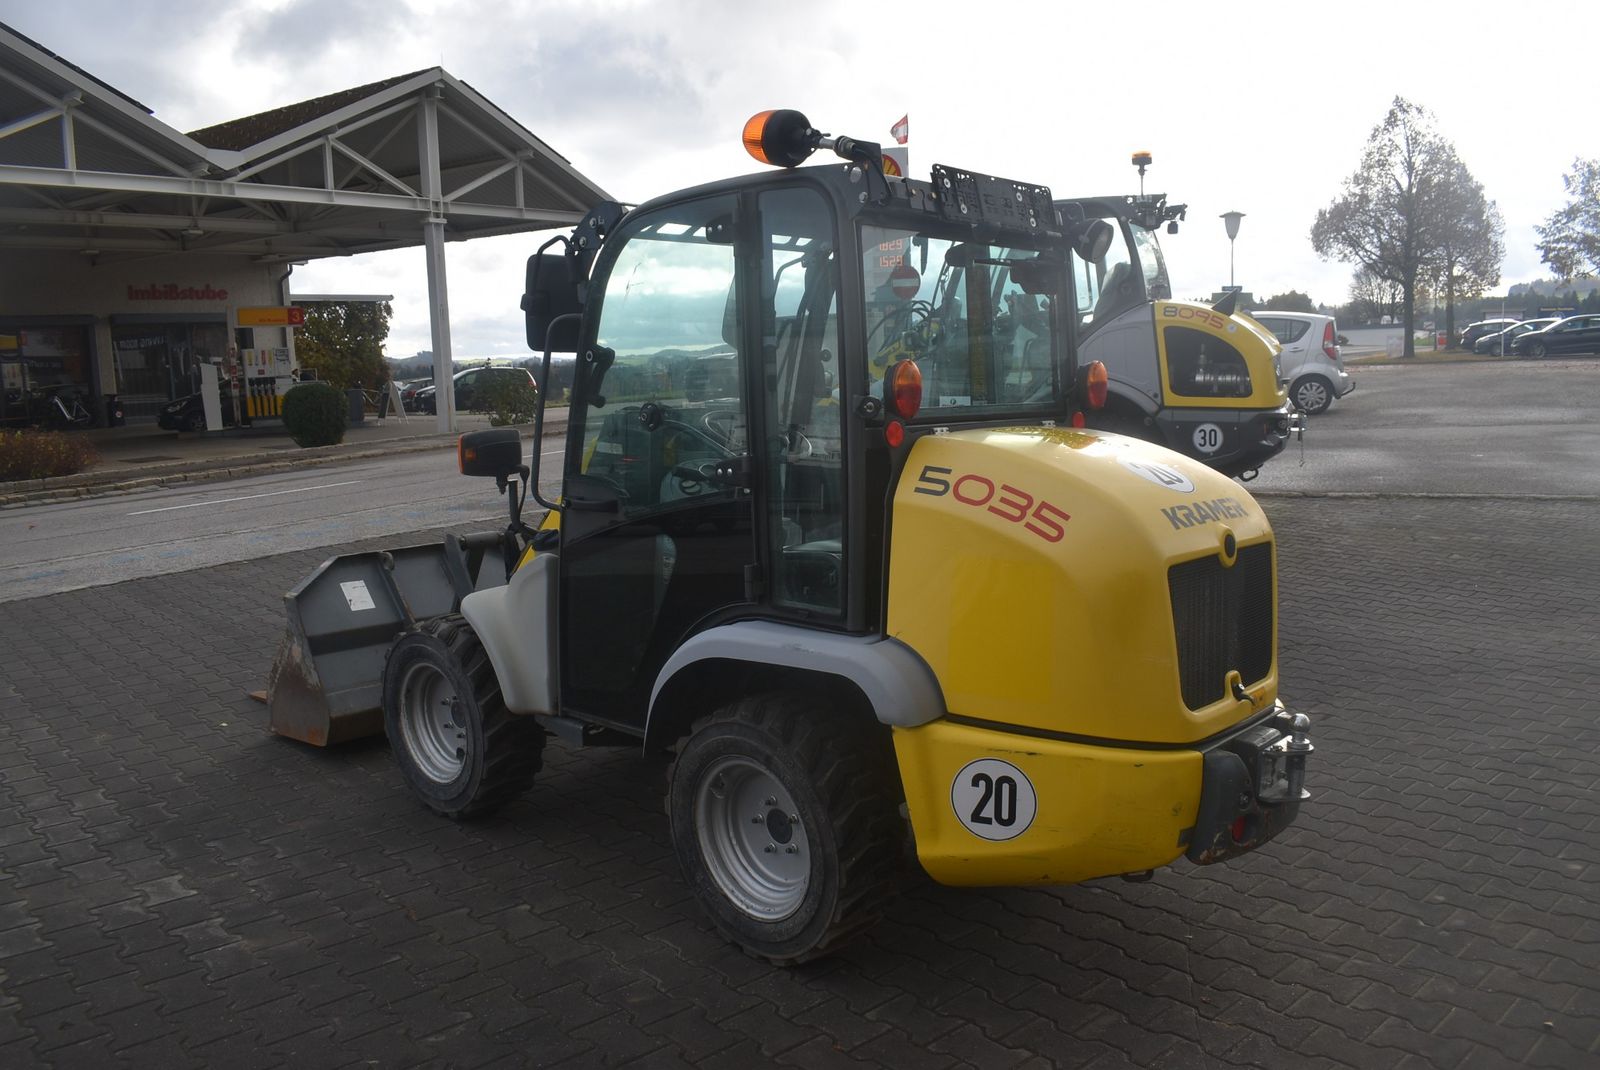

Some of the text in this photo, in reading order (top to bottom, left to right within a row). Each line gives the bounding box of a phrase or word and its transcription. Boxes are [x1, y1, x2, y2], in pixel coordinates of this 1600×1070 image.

[127, 283, 229, 301] Imbißstube
[292, 311, 300, 322] 3
[1163, 305, 1225, 329] 8095
[1198, 429, 1218, 448] 30
[913, 465, 1072, 544] 5035
[1160, 497, 1248, 530] KRAMER
[970, 772, 1018, 827] 20
